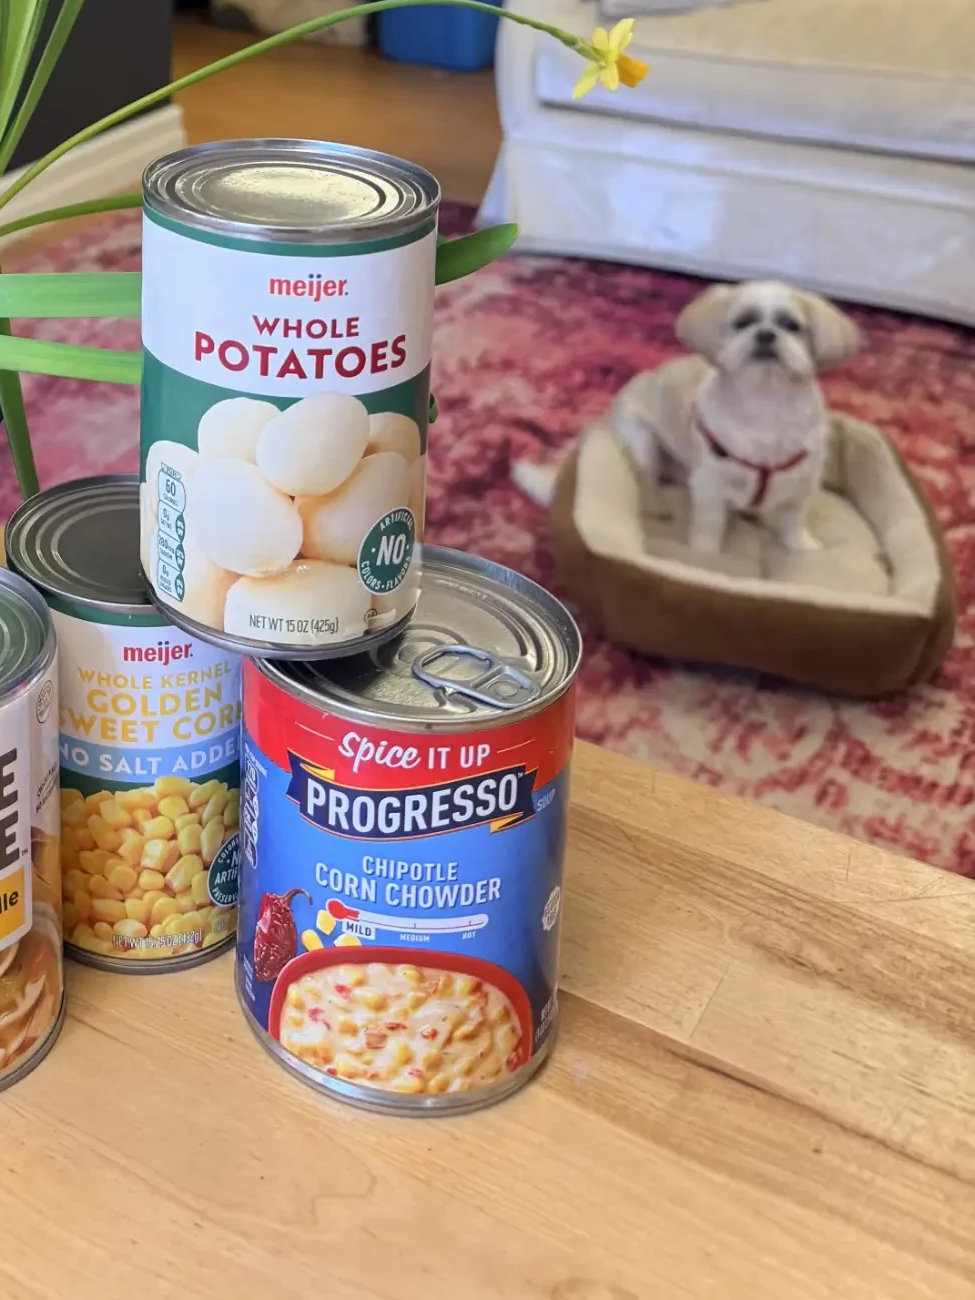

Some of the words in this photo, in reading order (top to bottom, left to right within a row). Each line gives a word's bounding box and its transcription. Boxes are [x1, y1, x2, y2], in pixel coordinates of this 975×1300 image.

[252, 315, 360, 339] WHOLE
[195, 331, 407, 380] POTATOES
[165, 479, 176, 497] 60
[380, 510, 414, 531] ARTIFICIAL
[376, 533, 407, 566] NO
[361, 560, 382, 591] COLORS
[386, 557, 412, 590] FLAVORS
[249, 614, 267, 629] NET
[269, 618, 284, 632] WT
[286, 619, 295, 632] 15
[297, 620, 309, 633] OZ
[311, 617, 339, 634] (425g)
[78, 666, 153, 690] WHOLE
[161, 660, 232, 689] KERNEL
[86, 682, 222, 717] GOLDEN
[99, 753, 162, 775] SALT
[172, 736, 235, 773] ADDE
[338, 731, 421, 773] Spice
[428, 747, 450, 769] IT
[460, 744, 490, 768] UP
[362, 855, 458, 882] CHIPOTLE
[315, 861, 377, 904] CORN
[385, 877, 502, 909] CHOWDER
[113, 935, 128, 947] NET
[167, 935, 177, 947] OZ
[346, 921, 372, 937] MILD
[400, 933, 430, 942] MEDIUM
